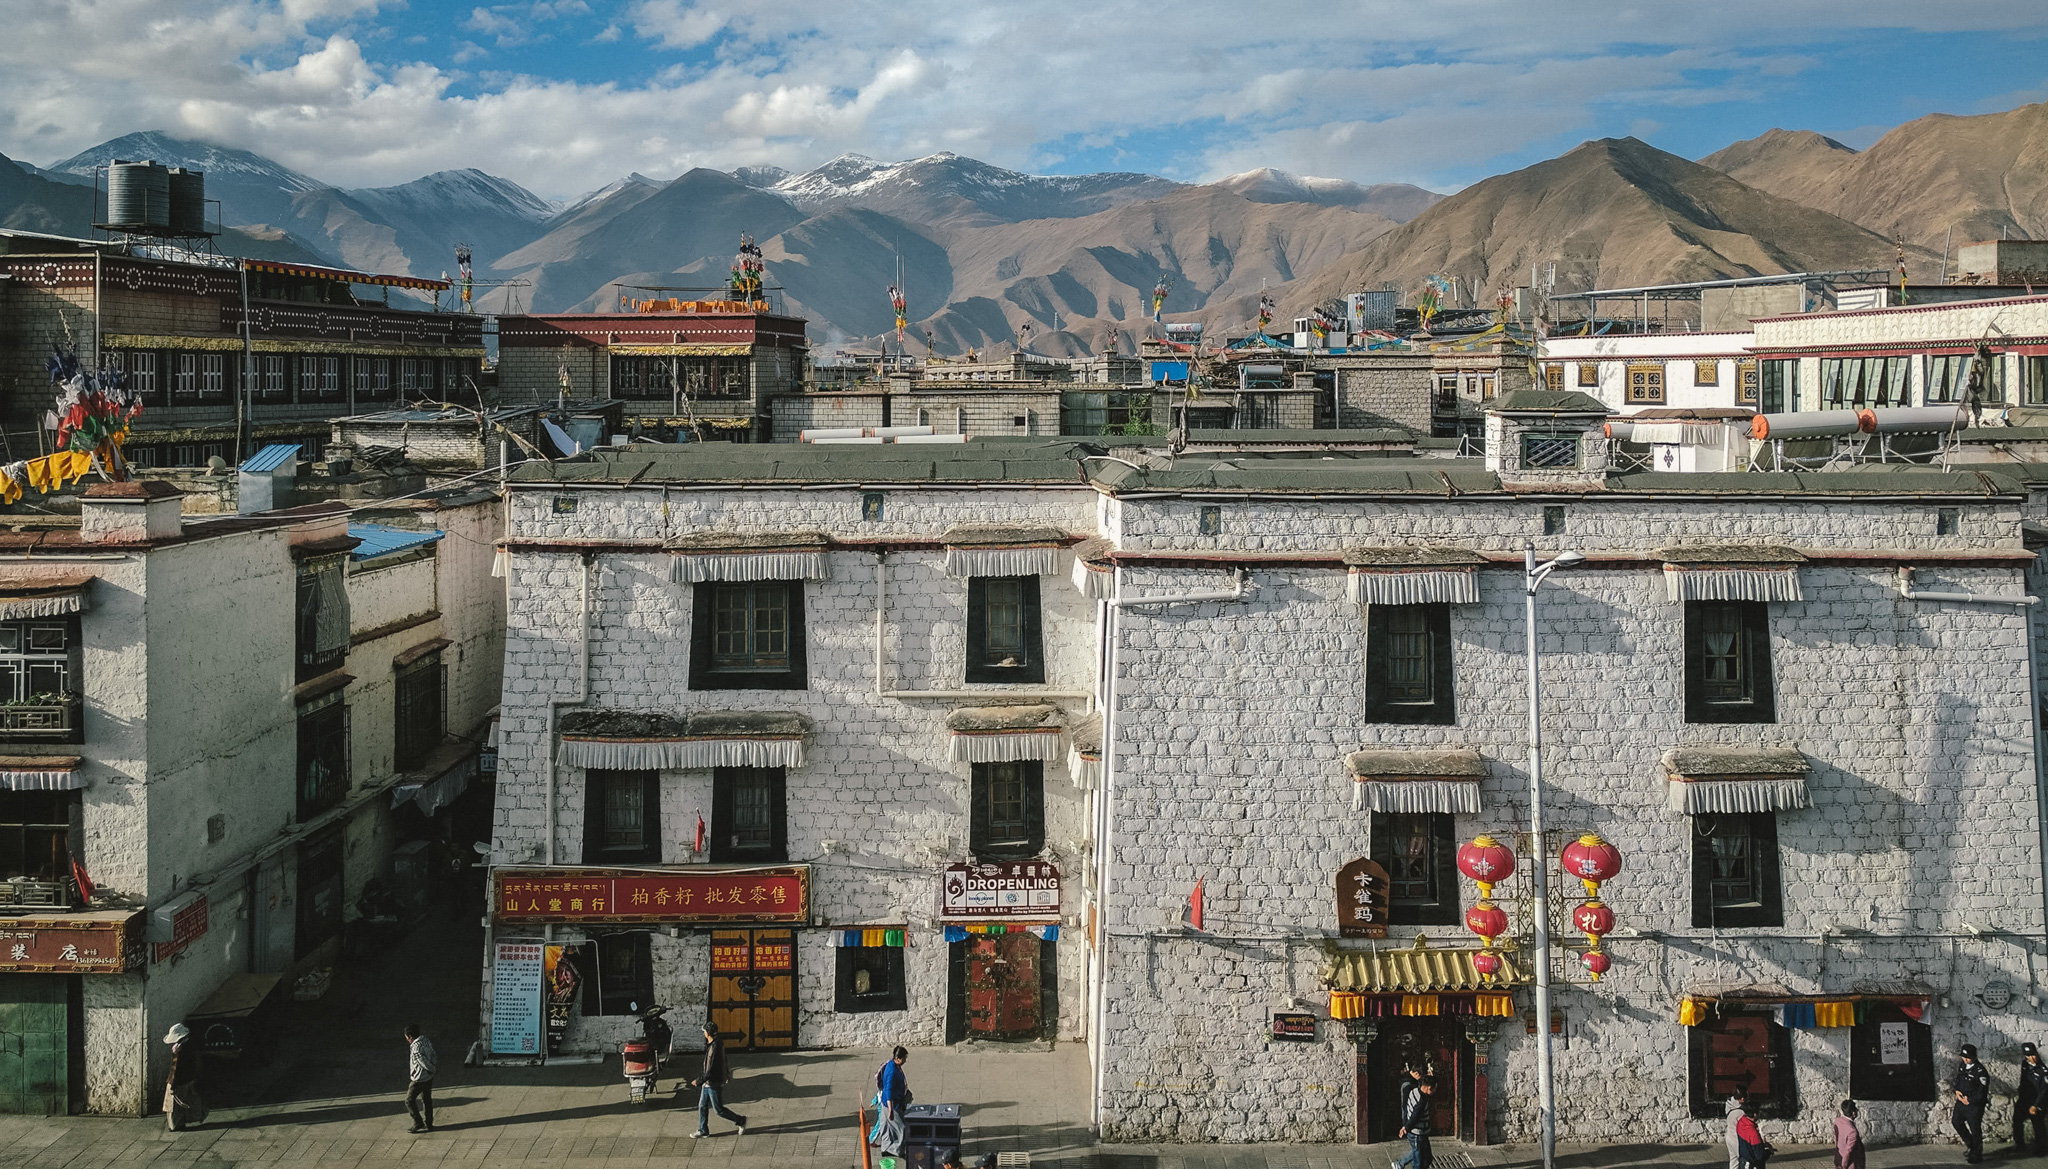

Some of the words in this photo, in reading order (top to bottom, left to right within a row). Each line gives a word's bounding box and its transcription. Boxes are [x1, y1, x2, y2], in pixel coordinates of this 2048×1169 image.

[967, 878, 1058, 890] DROPENLING
[506, 897, 606, 912] 山人堂商行
[631, 886, 695, 906] 柏香籽
[704, 885, 787, 905] 批发零售
[1353, 871, 1373, 922] 卡雀玛
